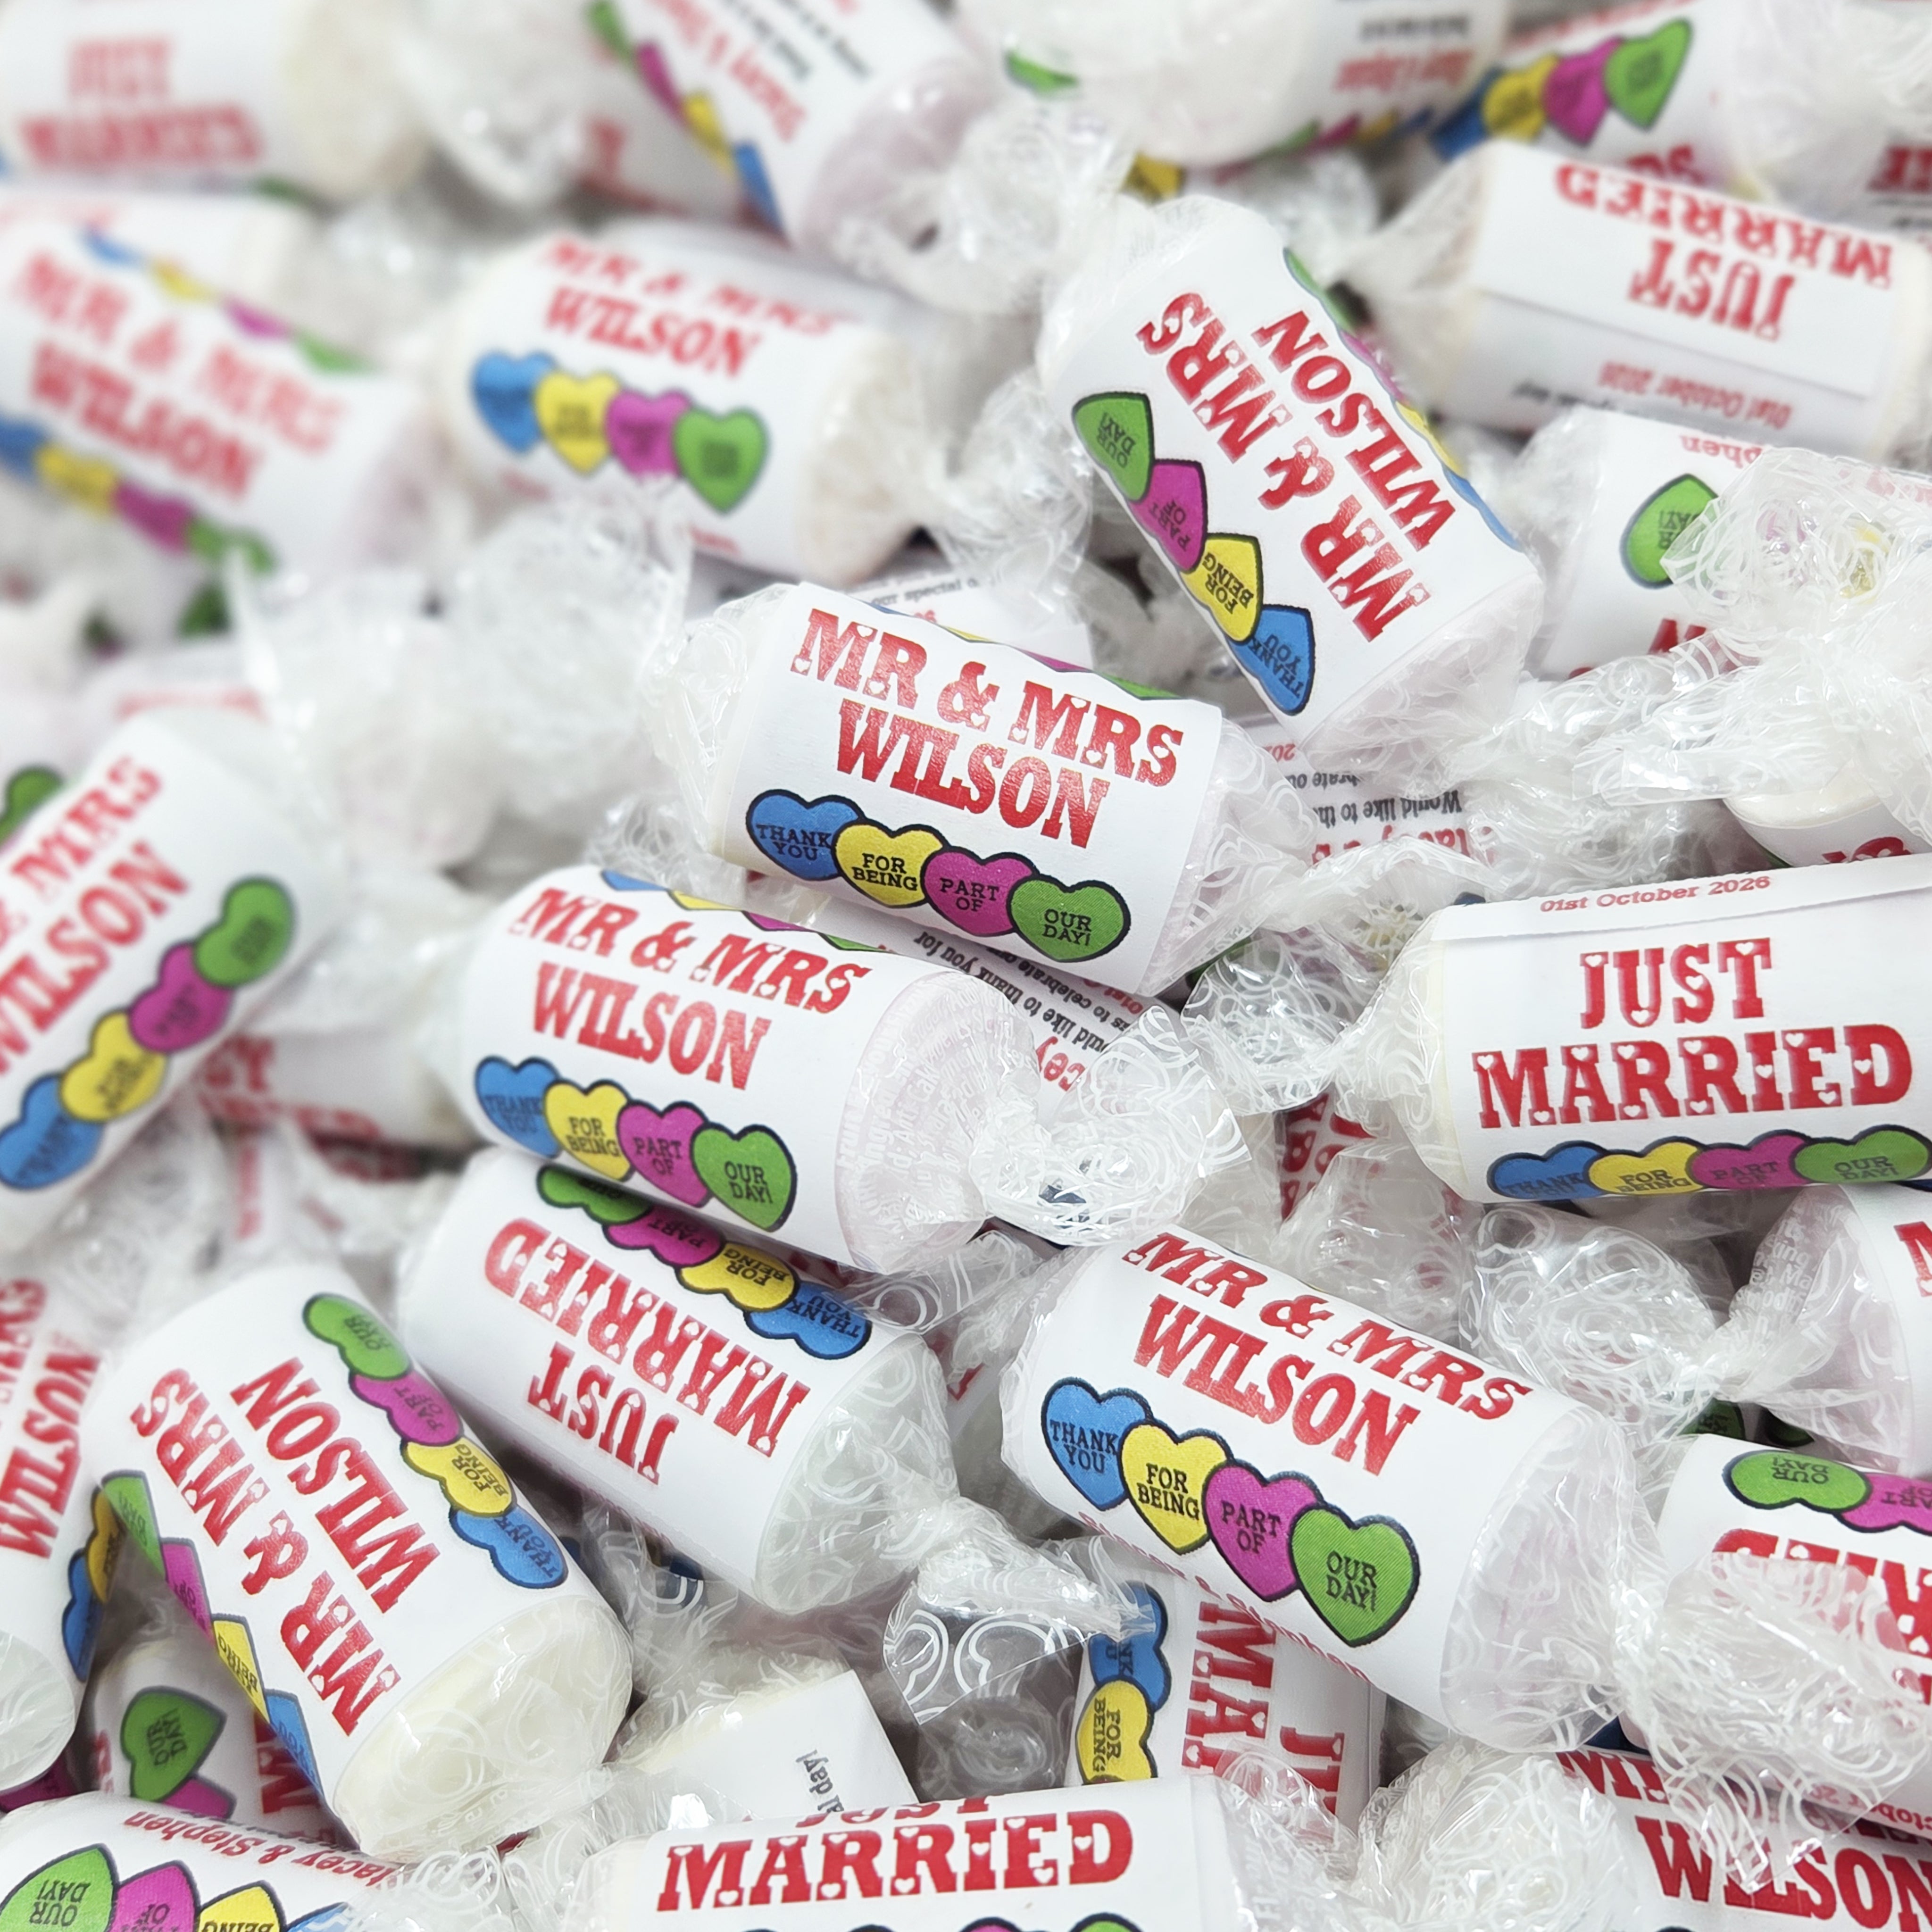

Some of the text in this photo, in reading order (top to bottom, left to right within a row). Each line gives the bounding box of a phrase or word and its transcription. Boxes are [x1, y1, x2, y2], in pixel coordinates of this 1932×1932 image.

[1554, 162, 1892, 289] MARRIED
[1626, 238, 1796, 341] JUST
[544, 284, 762, 376] WILSON
[1096, 429, 1128, 468] OUR
[1100, 413, 1136, 457] DAY!
[1251, 311, 1456, 552] WILSON
[1136, 292, 1431, 643] MR & MRS
[1149, 503, 1191, 551] PART
[1164, 500, 1187, 524] OF
[1203, 552, 1254, 609] BEING
[1205, 574, 1236, 614] FOR
[1249, 633, 1304, 698] THANK
[1264, 634, 1301, 675] YOU
[791, 608, 1185, 787] MR & MRS
[837, 698, 1110, 849] WILSON
[10, 754, 163, 903] MRS
[1341, 806, 1358, 824] to
[1363, 798, 1396, 822] like
[756, 824, 833, 848] THANK
[773, 841, 818, 861] YOU
[852, 867, 918, 891] BEING
[862, 853, 907, 874] FOR
[940, 877, 999, 900] PART
[956, 896, 983, 912] OF
[1540, 876, 1771, 913] 01st October 2026
[1043, 924, 1091, 947] DAY!
[1044, 909, 1091, 932] OUR
[508, 888, 872, 1014] MR & MRS
[914, 932, 943, 957] for
[941, 944, 978, 974] you
[1018, 960, 1091, 1008] celebrate
[1580, 937, 1773, 1030] JUST
[1024, 997, 1041, 1017] to
[1043, 1008, 1076, 1038] like
[1093, 1006, 1112, 1022] to
[533, 961, 772, 1091] WILSON
[1472, 1024, 1913, 1128] MARRIED
[484, 1095, 544, 1115] THANK
[566, 1134, 622, 1157] BEING
[568, 1117, 605, 1138] FOR
[633, 1137, 683, 1159] PART
[1834, 1156, 1890, 1172] OUR
[652, 1158, 675, 1176] OF
[724, 1161, 767, 1186] OUR
[1620, 1170, 1672, 1185] FOR
[1711, 1161, 1778, 1180] PART
[729, 1182, 774, 1204] DAY!
[648, 1218, 706, 1249] PART
[723, 1249, 790, 1282] BEING
[726, 1259, 770, 1286] FOR
[483, 1217, 811, 1458] MARRIED
[785, 1299, 859, 1339] THANK
[1122, 1232, 1533, 1420] MR & MRS
[1133, 1293, 1420, 1476] WILSON
[394, 1386, 444, 1432] PART
[527, 1341, 681, 1486] JUST
[1050, 1421, 1118, 1455] THANK
[130, 1368, 271, 1546] MRS
[452, 1456, 487, 1493] FOR
[456, 1443, 508, 1496] BEING
[1064, 1444, 1107, 1473] YOU
[1772, 1467, 1828, 1484] OUR
[229, 1357, 440, 1614] WILSON
[1146, 1463, 1189, 1494] FOR
[1137, 1484, 1199, 1520] BEING
[1221, 1500, 1282, 1539] PART
[242, 1511, 308, 1595] &
[494, 1516, 560, 1579] THANK
[1237, 1531, 1265, 1554] OF
[1326, 1550, 1377, 1589] OUR
[1326, 1576, 1377, 1612] DAY!
[281, 1570, 401, 1736] MR
[147, 1716, 167, 1767] OUR
[1092, 1698, 1106, 1772] BEING
[1106, 1708, 1120, 1760] FOR
[124, 1810, 266, 1857] Stephen
[259, 1843, 296, 1864] &
[657, 1810, 1132, 1911] MARRIED
[38, 1879, 91, 1904] DAY!
[30, 1902, 79, 1927] OUR
[142, 1904, 170, 1926] OF
